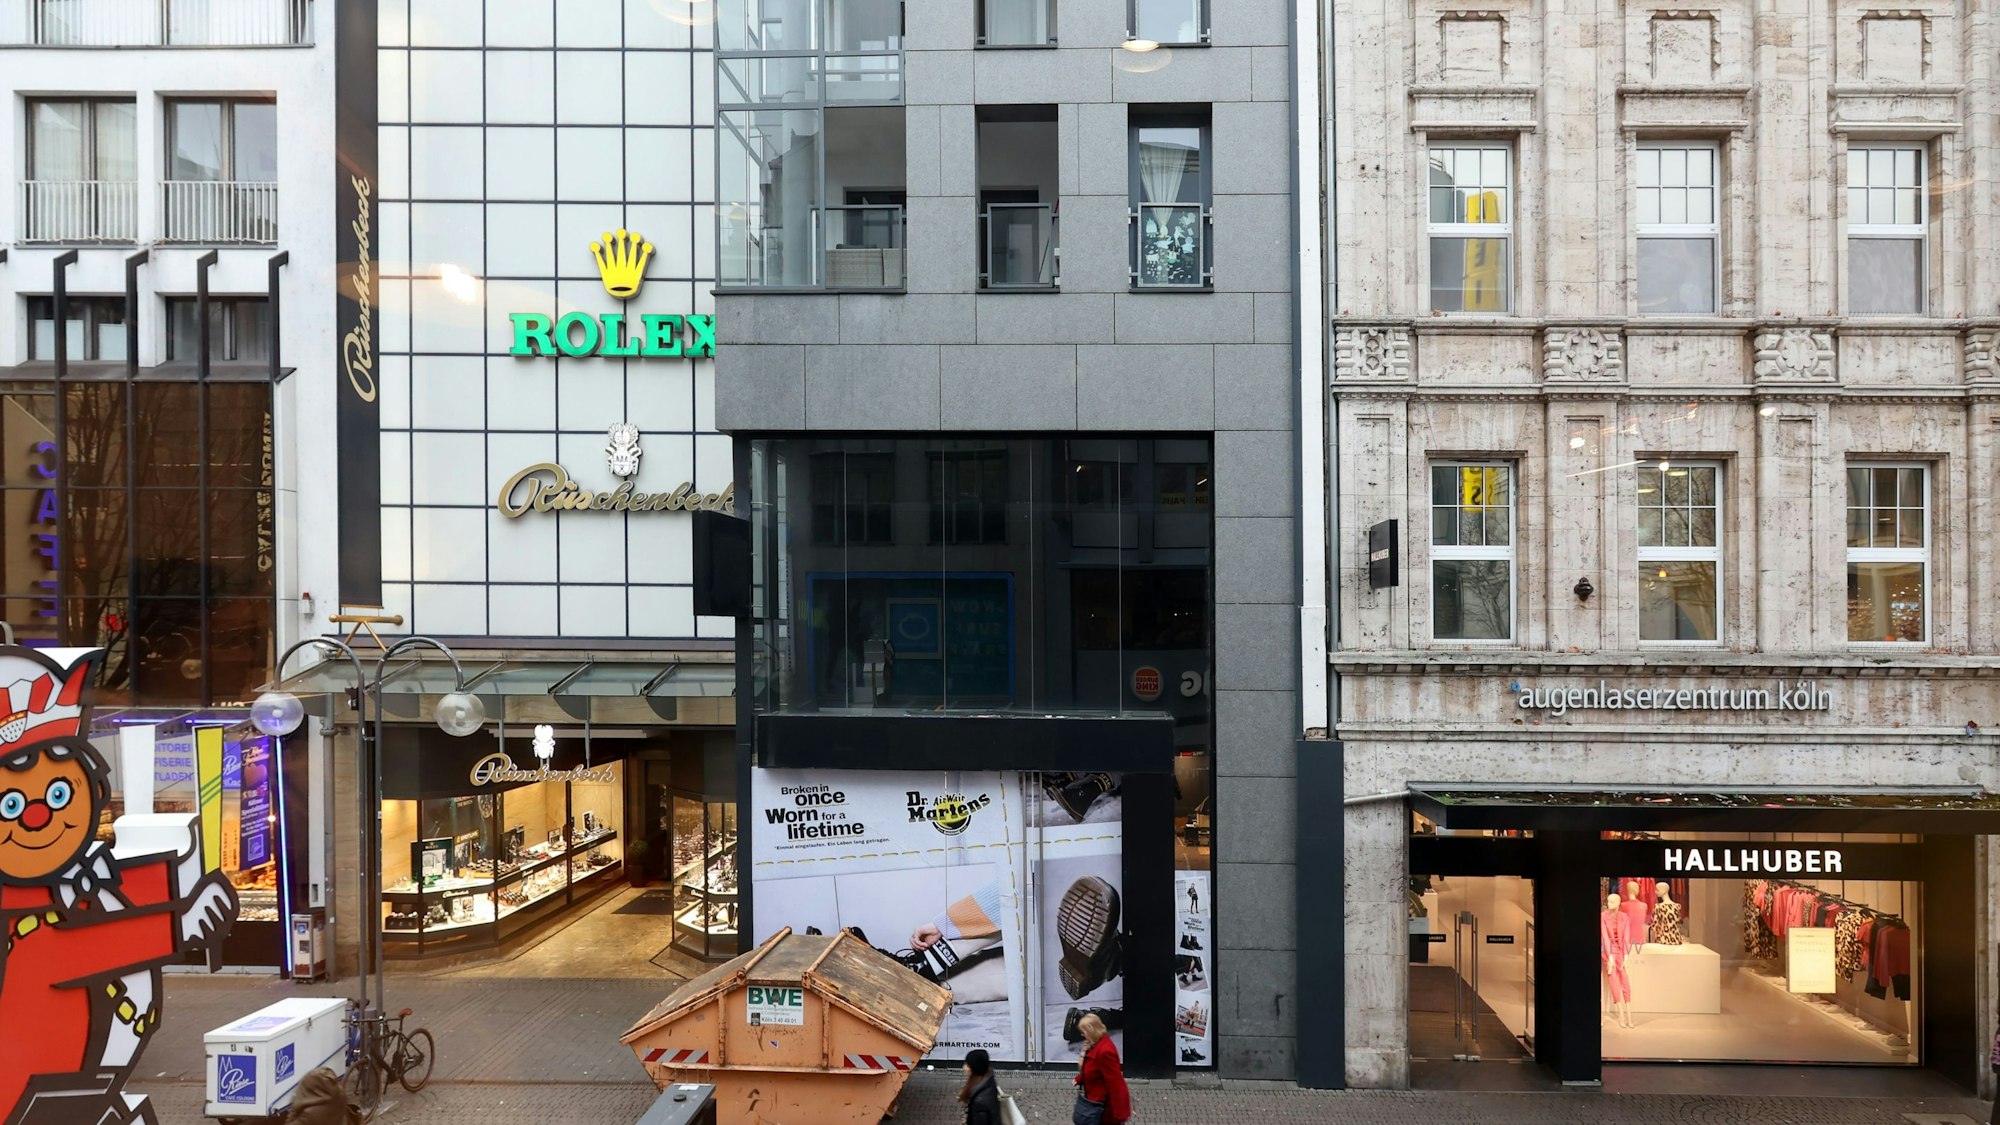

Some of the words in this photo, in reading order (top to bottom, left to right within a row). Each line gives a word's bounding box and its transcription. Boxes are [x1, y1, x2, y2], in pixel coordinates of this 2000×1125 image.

[344, 175, 376, 404] Rüschenbeck
[508, 312, 716, 358] ROLEX
[497, 462, 735, 519] Rüschenbeck
[1517, 681, 1770, 717] augenlaserzentrum
[1778, 680, 1834, 711] köln
[470, 753, 617, 786] Rüschenbeck
[781, 786, 818, 795] Broken
[820, 784, 829, 792] in
[795, 791, 845, 806] once
[906, 791, 929, 806] Dr.
[765, 808, 818, 824] Worn
[821, 812, 836, 820] for
[907, 793, 991, 823] Martens
[787, 821, 864, 839] lifetime
[1664, 849, 1843, 873] HALLHUBER
[748, 987, 802, 1006] BWE
